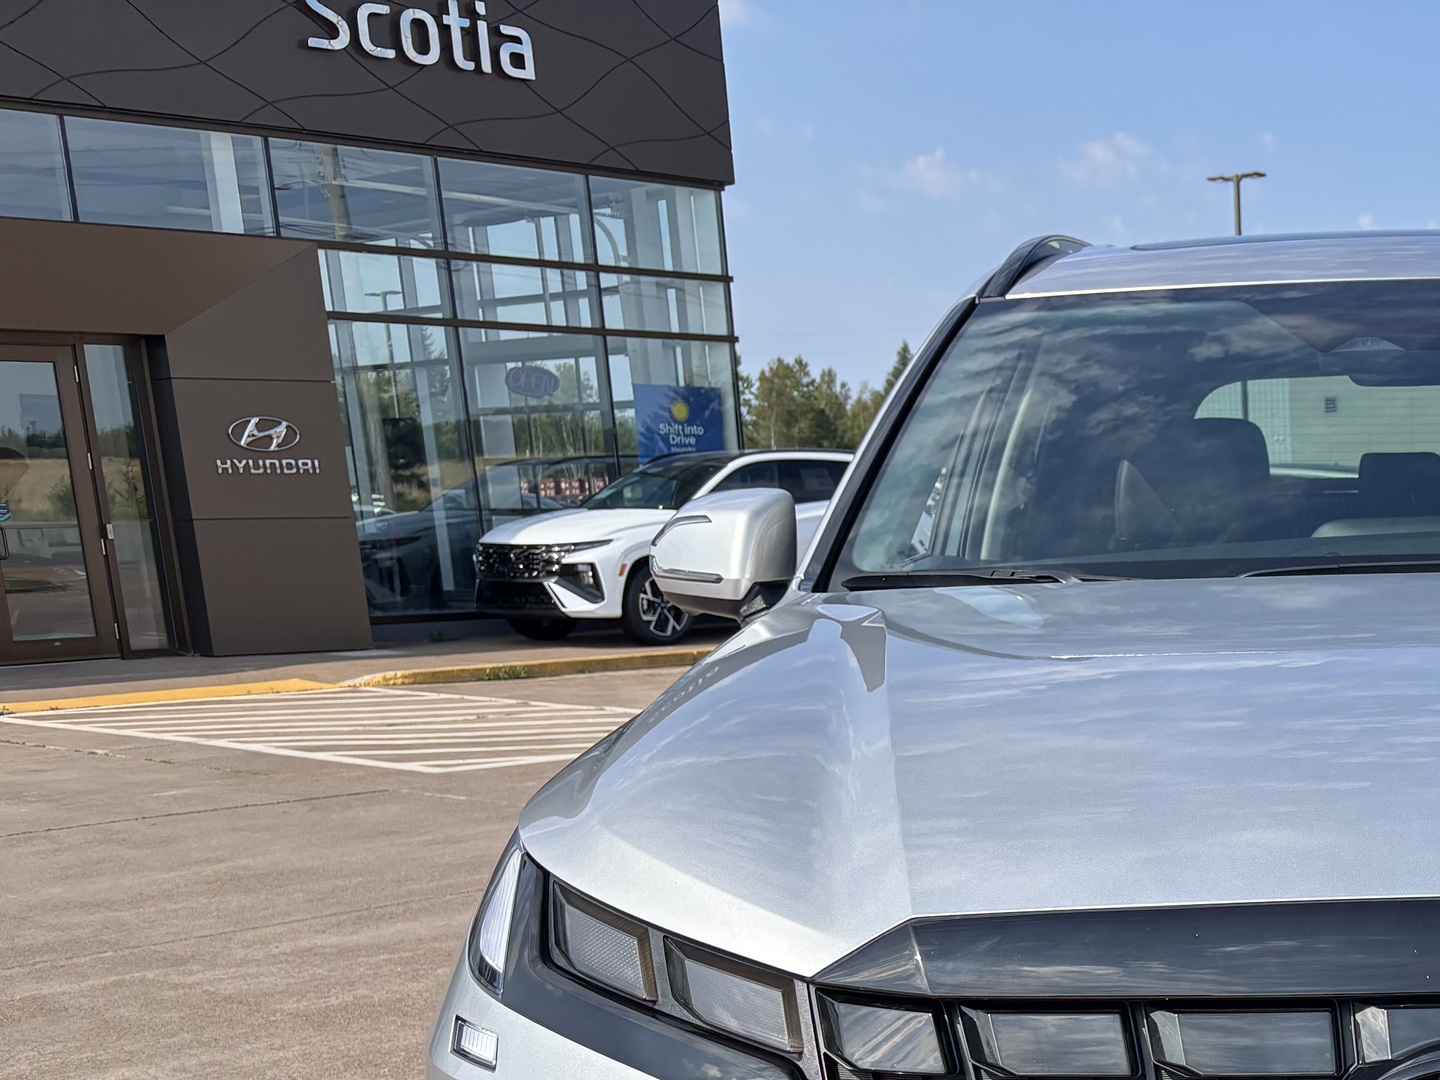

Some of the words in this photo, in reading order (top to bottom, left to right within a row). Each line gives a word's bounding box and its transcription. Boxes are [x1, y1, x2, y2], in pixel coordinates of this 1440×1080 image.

[304, 0, 537, 81] Scotia
[509, 369, 555, 394] OPEN
[659, 423, 683, 435] Shift
[684, 423, 704, 436] into
[669, 434, 696, 445] Drive
[216, 459, 321, 475] HYUNDAI
